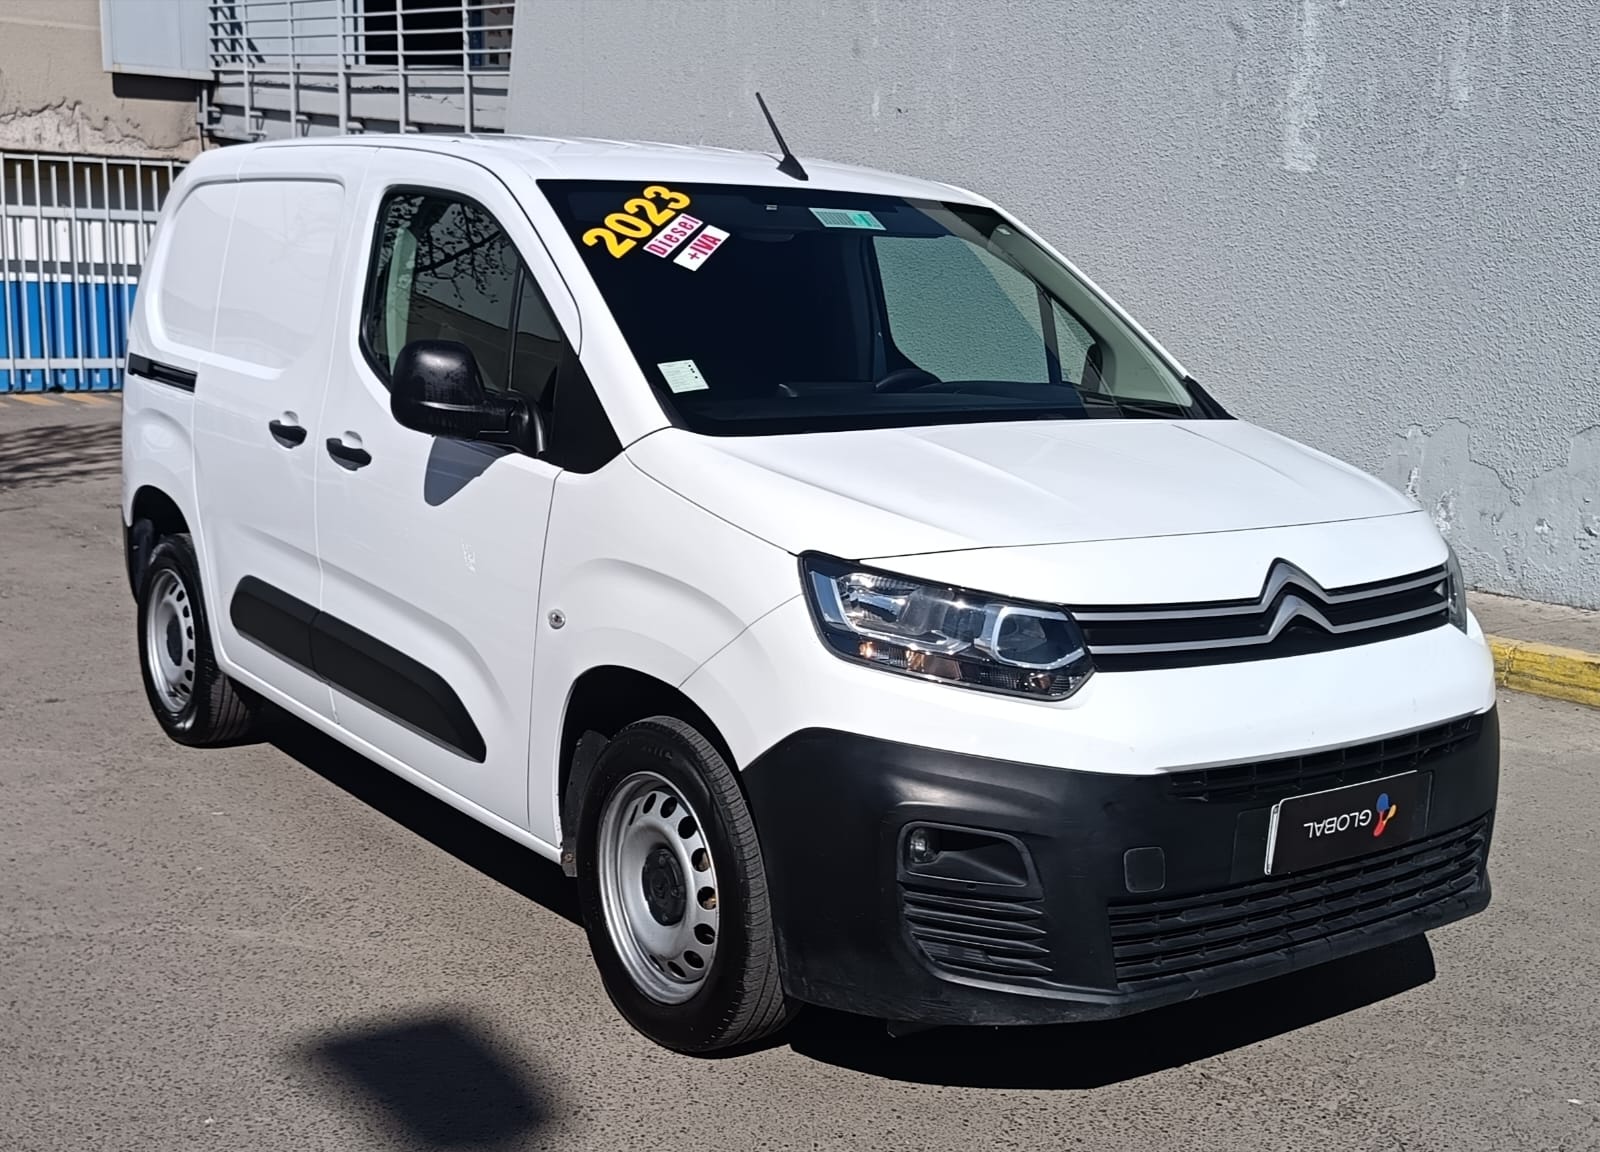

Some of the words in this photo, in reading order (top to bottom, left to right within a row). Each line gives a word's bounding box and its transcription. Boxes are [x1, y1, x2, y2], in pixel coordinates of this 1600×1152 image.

[582, 185, 690, 258] 2023
[646, 215, 700, 255] Diesel
[687, 233, 722, 260] +IVA
[1303, 809, 1372, 838] GLOBAL
